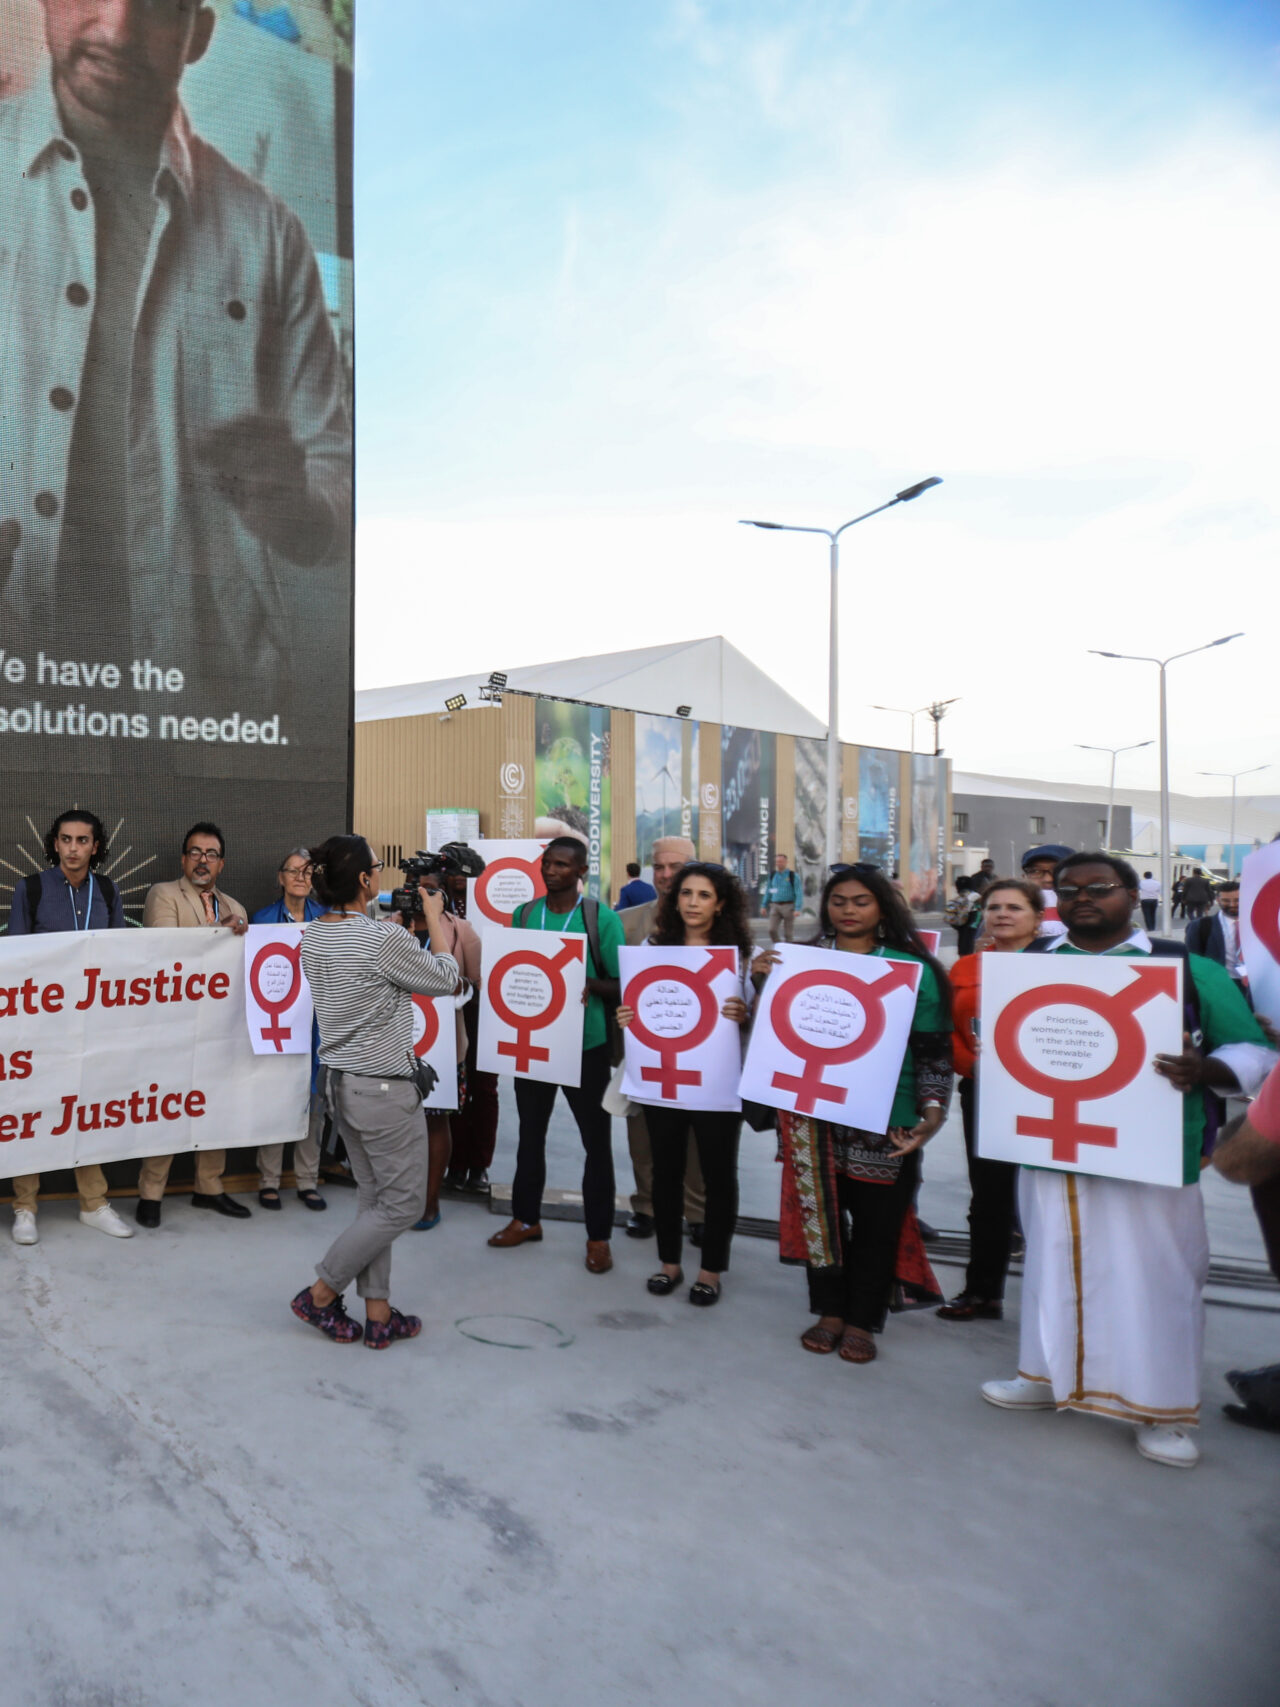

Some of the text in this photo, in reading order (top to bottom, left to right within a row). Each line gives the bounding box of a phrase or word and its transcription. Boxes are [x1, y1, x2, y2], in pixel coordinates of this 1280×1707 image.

[37, 652, 121, 688] have
[131, 659, 184, 693] the
[160, 713, 289, 745] needed.
[589, 732, 602, 875] BIODIVERSITY
[760, 798, 769, 875] FINANCE
[76, 962, 230, 1011] Justice
[1046, 1016, 1088, 1025] Prioritise
[1042, 1049, 1092, 1058] renewable
[1065, 1039, 1086, 1047] shift
[1050, 1060, 1083, 1069] energy
[51, 1083, 206, 1135] Justice
